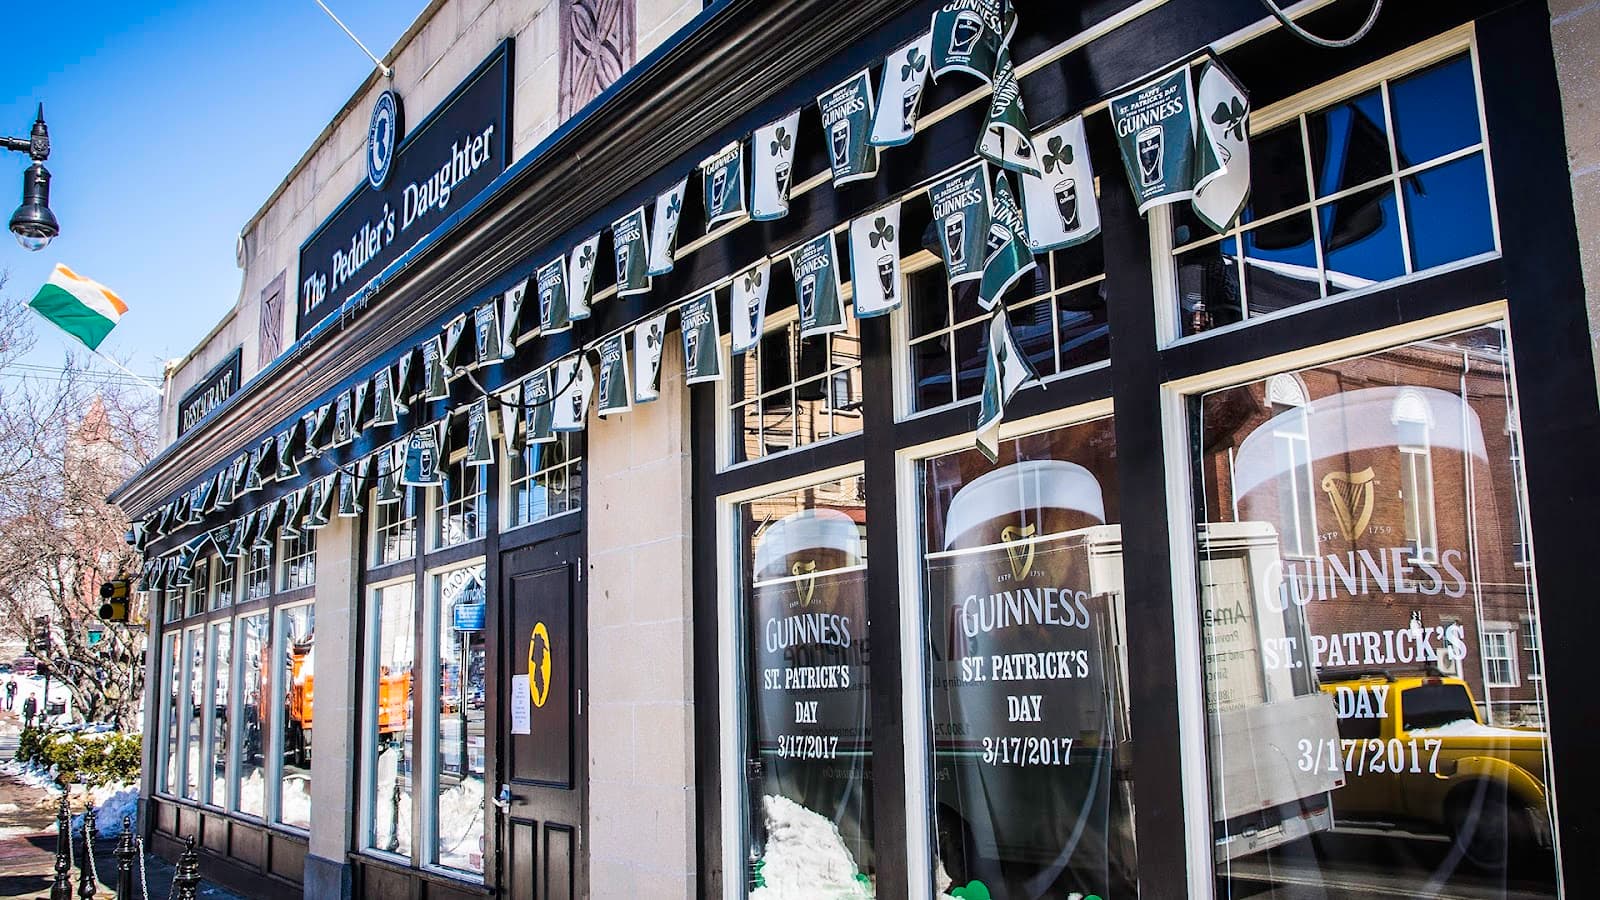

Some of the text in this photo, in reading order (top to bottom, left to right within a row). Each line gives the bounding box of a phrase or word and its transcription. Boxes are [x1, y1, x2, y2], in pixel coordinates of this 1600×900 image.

[1164, 85, 1178, 97] DAY
[821, 96, 865, 129] GUINNESS
[1117, 96, 1184, 137] GUINNESS
[303, 271, 327, 316] The
[331, 203, 395, 293] Peddler's
[401, 124, 495, 231] Daughter
[932, 188, 982, 221] GUINNESS
[1262, 547, 1467, 614] GUINNESS
[962, 587, 1090, 638] GUINNESS
[765, 613, 851, 653] GUINNESS
[1264, 623, 1468, 670] ST. PATRICK'S
[764, 668, 782, 690] ST.
[785, 665, 850, 689] PATRICK'S
[961, 650, 1089, 683] ST. PATRICK'S
[795, 701, 818, 723] DAY
[1007, 696, 1042, 722] DAY
[1336, 685, 1389, 719] DAY
[777, 735, 838, 760] 3/17/2017
[982, 736, 1073, 767] 3/17/2017
[1298, 738, 1442, 777] 3/17/2017
